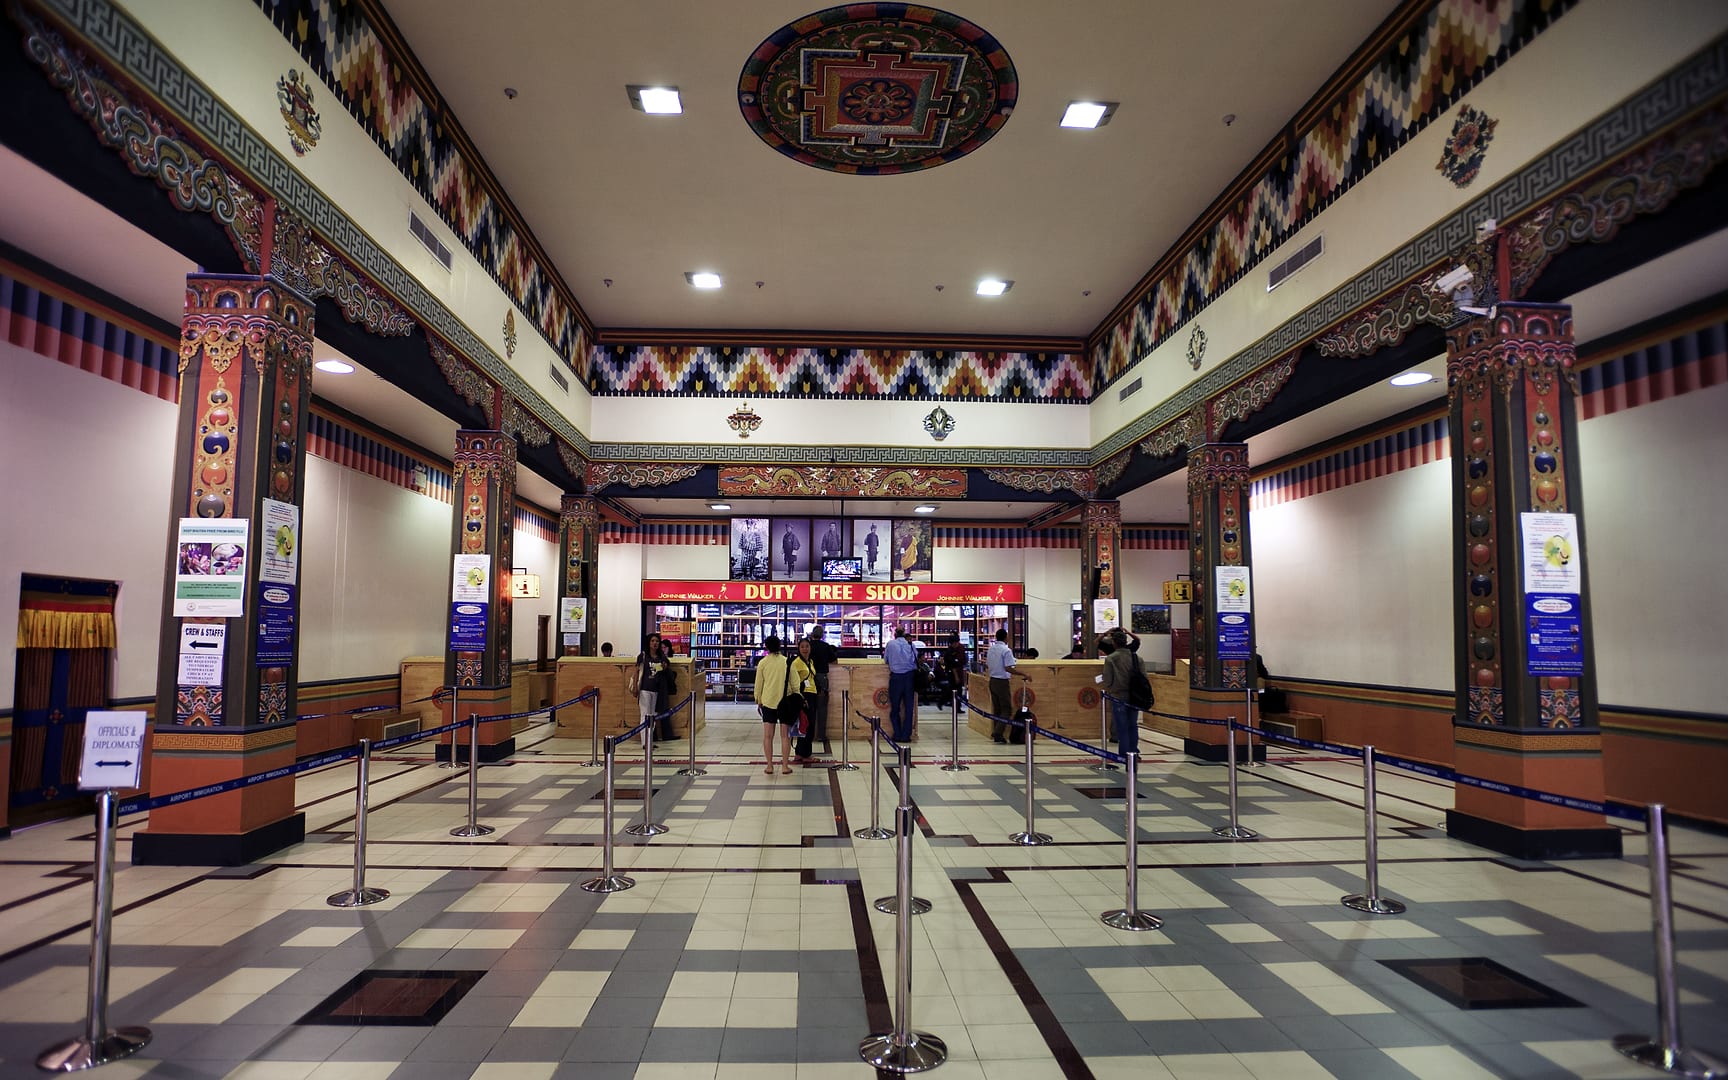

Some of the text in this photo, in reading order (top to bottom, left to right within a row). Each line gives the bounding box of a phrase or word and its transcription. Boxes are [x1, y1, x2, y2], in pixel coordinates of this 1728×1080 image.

[745, 584, 920, 600] DUTY FREE SHOP
[206, 629, 224, 637] STAFFS
[98, 726, 136, 736] OFFICIALS &
[92, 740, 140, 749] DIPLOMATS
[247, 768, 289, 784] AIRPORT IMMIGRATION
[170, 785, 223, 802] AIRPORT IMMIGRATION
[1565, 799, 1603, 812] IMMIGRATION
